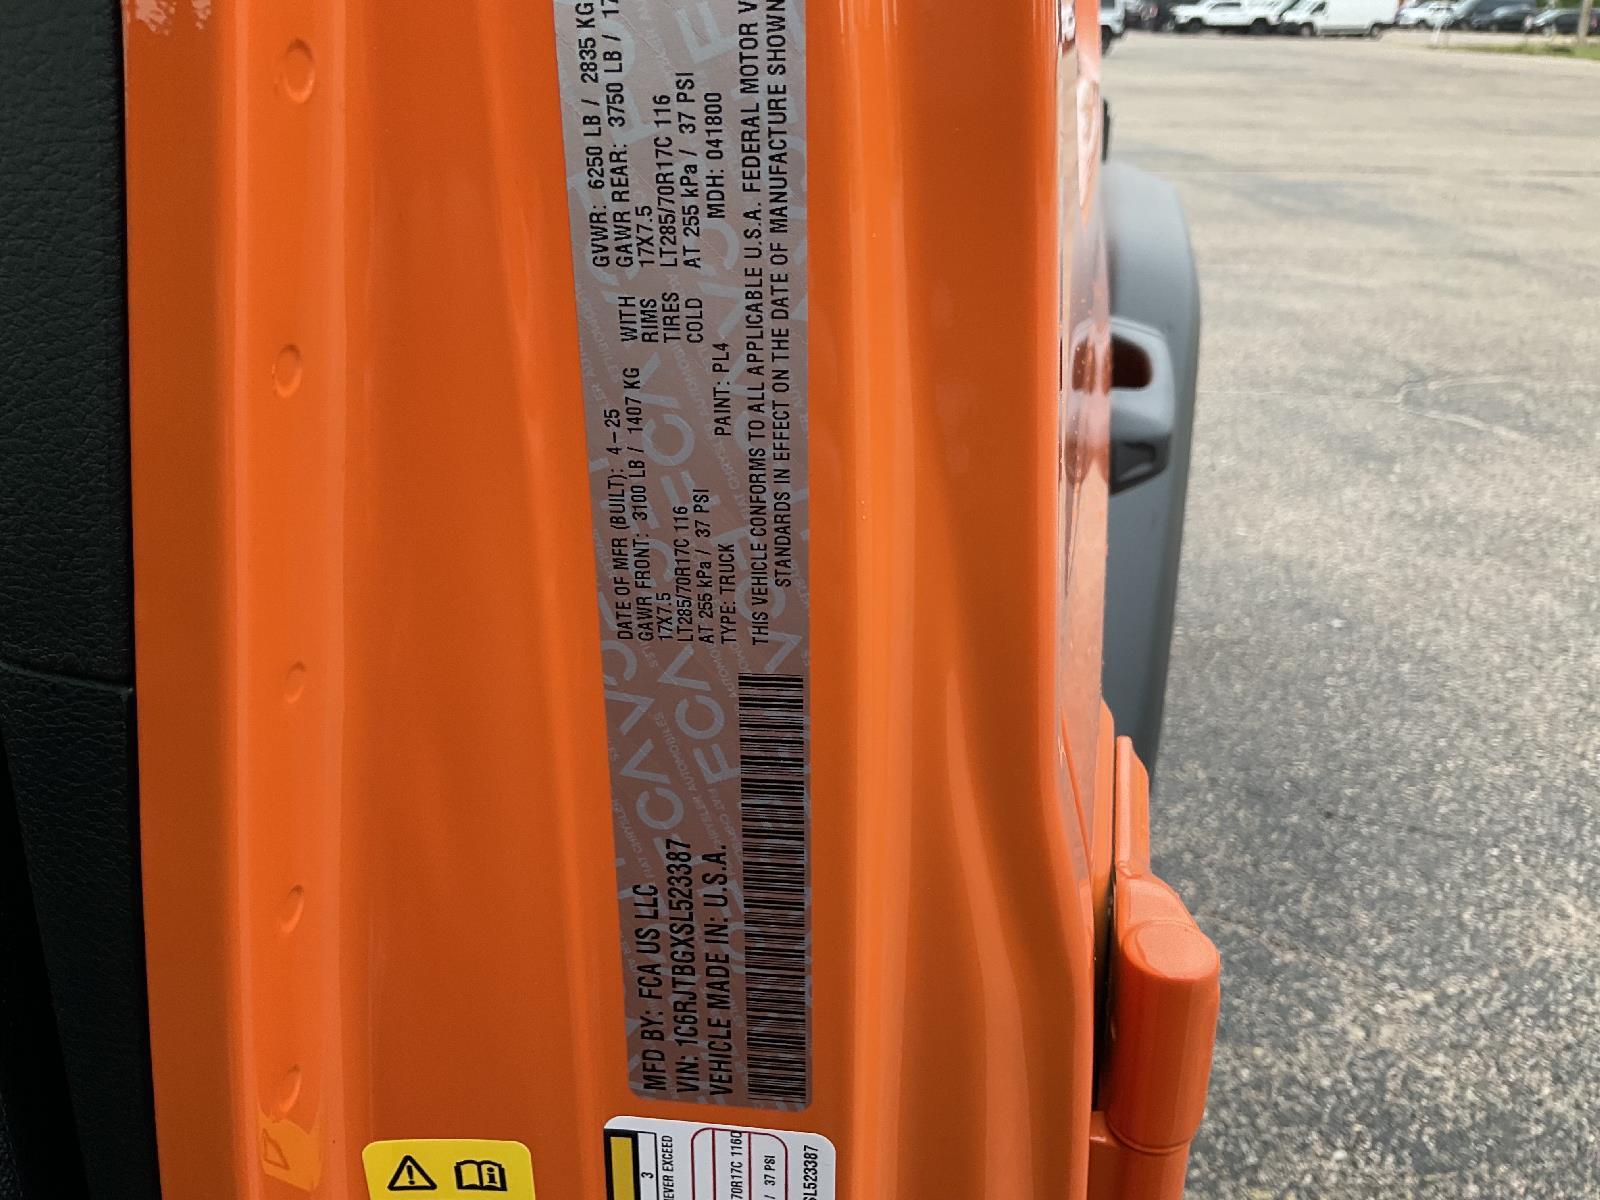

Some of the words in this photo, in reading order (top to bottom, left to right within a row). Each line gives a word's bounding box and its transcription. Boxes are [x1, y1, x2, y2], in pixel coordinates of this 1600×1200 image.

[576, 2, 595, 28] KG
[766, 0, 787, 75] SHOWN
[578, 37, 598, 83] 2835
[604, 51, 622, 73] LB
[738, 22, 759, 94] MOTOR
[581, 98, 600, 106] /
[606, 83, 625, 127] 3750
[675, 72, 695, 103] PSI
[583, 115, 601, 136] LB
[653, 95, 671, 127] 116
[678, 112, 695, 134] 37
[704, 93, 723, 160] 041800
[740, 103, 761, 192] FEDERAL
[766, 84, 789, 234] MANUFACTURE
[586, 146, 605, 189] 6250
[609, 143, 629, 202] REAR:
[681, 164, 699, 197] kPa
[654, 137, 677, 267] LT285/70R17C
[707, 169, 725, 218] MDH:
[588, 205, 609, 267] GVWR:
[612, 211, 634, 267] GAWR
[635, 206, 655, 267] 17X7.5
[682, 205, 699, 237] 255
[743, 202, 762, 258] U.S.A.
[682, 246, 701, 269] AT
[770, 243, 788, 265] OF
[770, 273, 789, 320] DATE
[618, 296, 638, 341] WITH
[640, 298, 660, 343] RIMS
[662, 292, 681, 343] TIRES
[685, 298, 703, 343] COLD
[744, 267, 764, 376] APPLICABLE
[712, 343, 729, 373] PL4
[771, 328, 789, 362] THE
[623, 368, 640, 389] KG
[771, 369, 789, 392] ON
[625, 397, 642, 434] 1407
[713, 381, 731, 436] PAINT:
[747, 383, 764, 413] ALL
[748, 420, 765, 441] TO
[772, 400, 790, 460] EFFECT
[628, 460, 645, 478] LB
[774, 469, 790, 484] IN
[608, 469, 629, 529] (BUILT):
[630, 486, 647, 521] 3100
[693, 489, 709, 513] PSI
[749, 448, 766, 536] CONFORMS
[673, 506, 689, 530] 116
[695, 520, 710, 537] 37
[612, 538, 628, 570] MFR
[773, 492, 791, 587] STANDARDS
[633, 534, 651, 588] FRONT:
[695, 562, 711, 587] kPa
[718, 544, 735, 594] TRUCK
[750, 543, 767, 606] VEHICLE
[614, 577, 630, 595] OF
[675, 539, 694, 642] LT285/70R17C
[616, 602, 632, 640] DATE
[637, 597, 654, 641] GAWR
[656, 593, 672, 641] 17X7.5
[697, 593, 712, 618] 255
[720, 601, 736, 644] TYPE:
[698, 625, 713, 644] AT
[752, 612, 769, 646] THIS
[702, 845, 727, 908] U.S.A.
[633, 884, 658, 920] LLC
[635, 928, 660, 954] US
[666, 839, 699, 1046] 1C6RJTBGXSL523387
[704, 917, 728, 944] IN:
[638, 963, 662, 999] FCA
[706, 953, 730, 1009] MADE
[640, 1011, 664, 1041] BY:
[642, 1049, 666, 1091] MFD
[676, 1056, 699, 1092] VIN:
[707, 1018, 732, 1095] VEHICLE
[662, 1136, 673, 1171] EXCEED
[764, 1155, 775, 1171] PSI
[764, 1174, 775, 1186] 37
